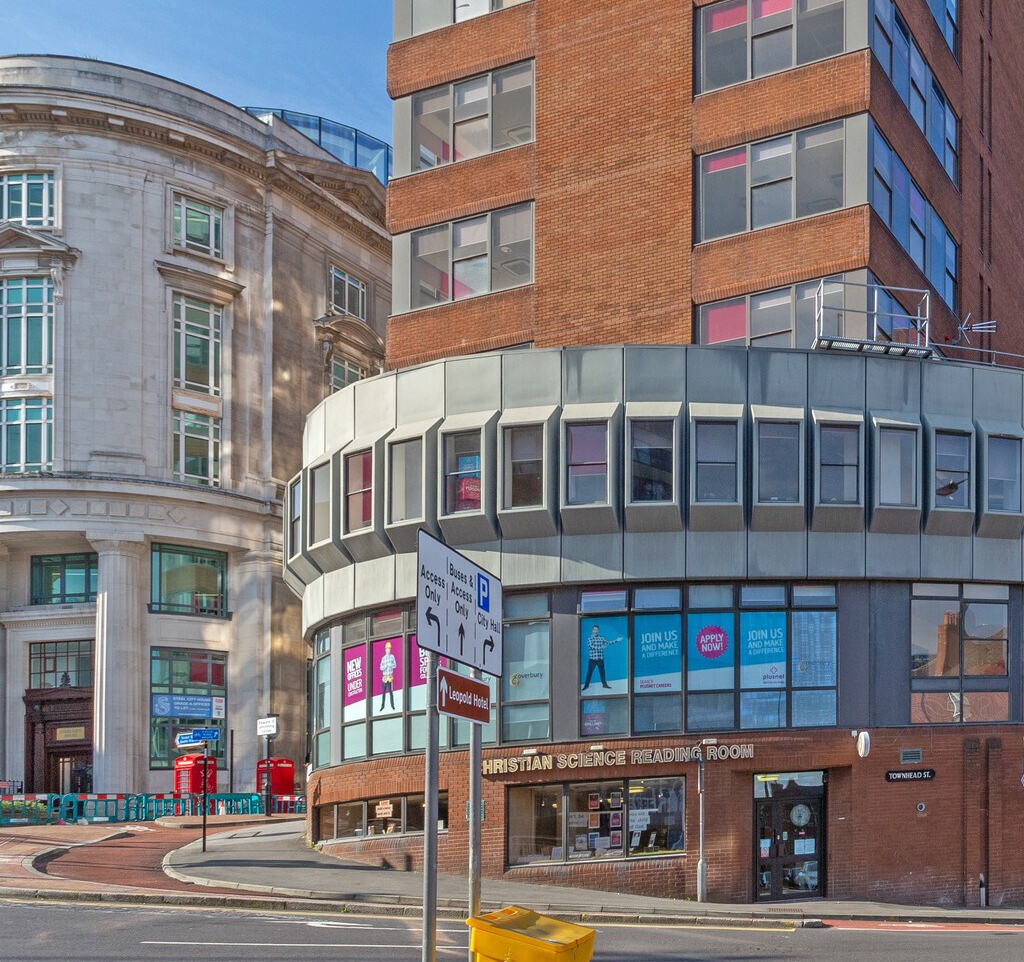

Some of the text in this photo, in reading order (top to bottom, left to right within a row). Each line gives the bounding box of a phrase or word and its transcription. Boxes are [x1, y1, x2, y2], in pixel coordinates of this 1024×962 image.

[420, 564, 445, 590] Access
[450, 563, 474, 589] Buses &
[424, 585, 441, 606] Only
[451, 582, 473, 604] Access
[479, 576, 488, 607] P
[455, 600, 469, 620] Only
[477, 611, 501, 635] City Hall
[641, 630, 679, 644] JOIN US
[700, 633, 724, 644] APPLY
[747, 627, 784, 641] JOIN US
[641, 641, 679, 652] AND MAKE
[701, 642, 724, 652] NOW!
[748, 638, 784, 649] AND MAKE
[753, 647, 785, 655] DIFFERENCE
[647, 649, 680, 658] DIFFERENCE
[347, 657, 362, 674] NEW
[348, 679, 363, 692] UNDER
[449, 685, 489, 710] Leopold Hotel
[481, 744, 754, 775] HRISTIAN SCIENCE READING ROOM
[888, 772, 922, 780] TOWNHEAD
